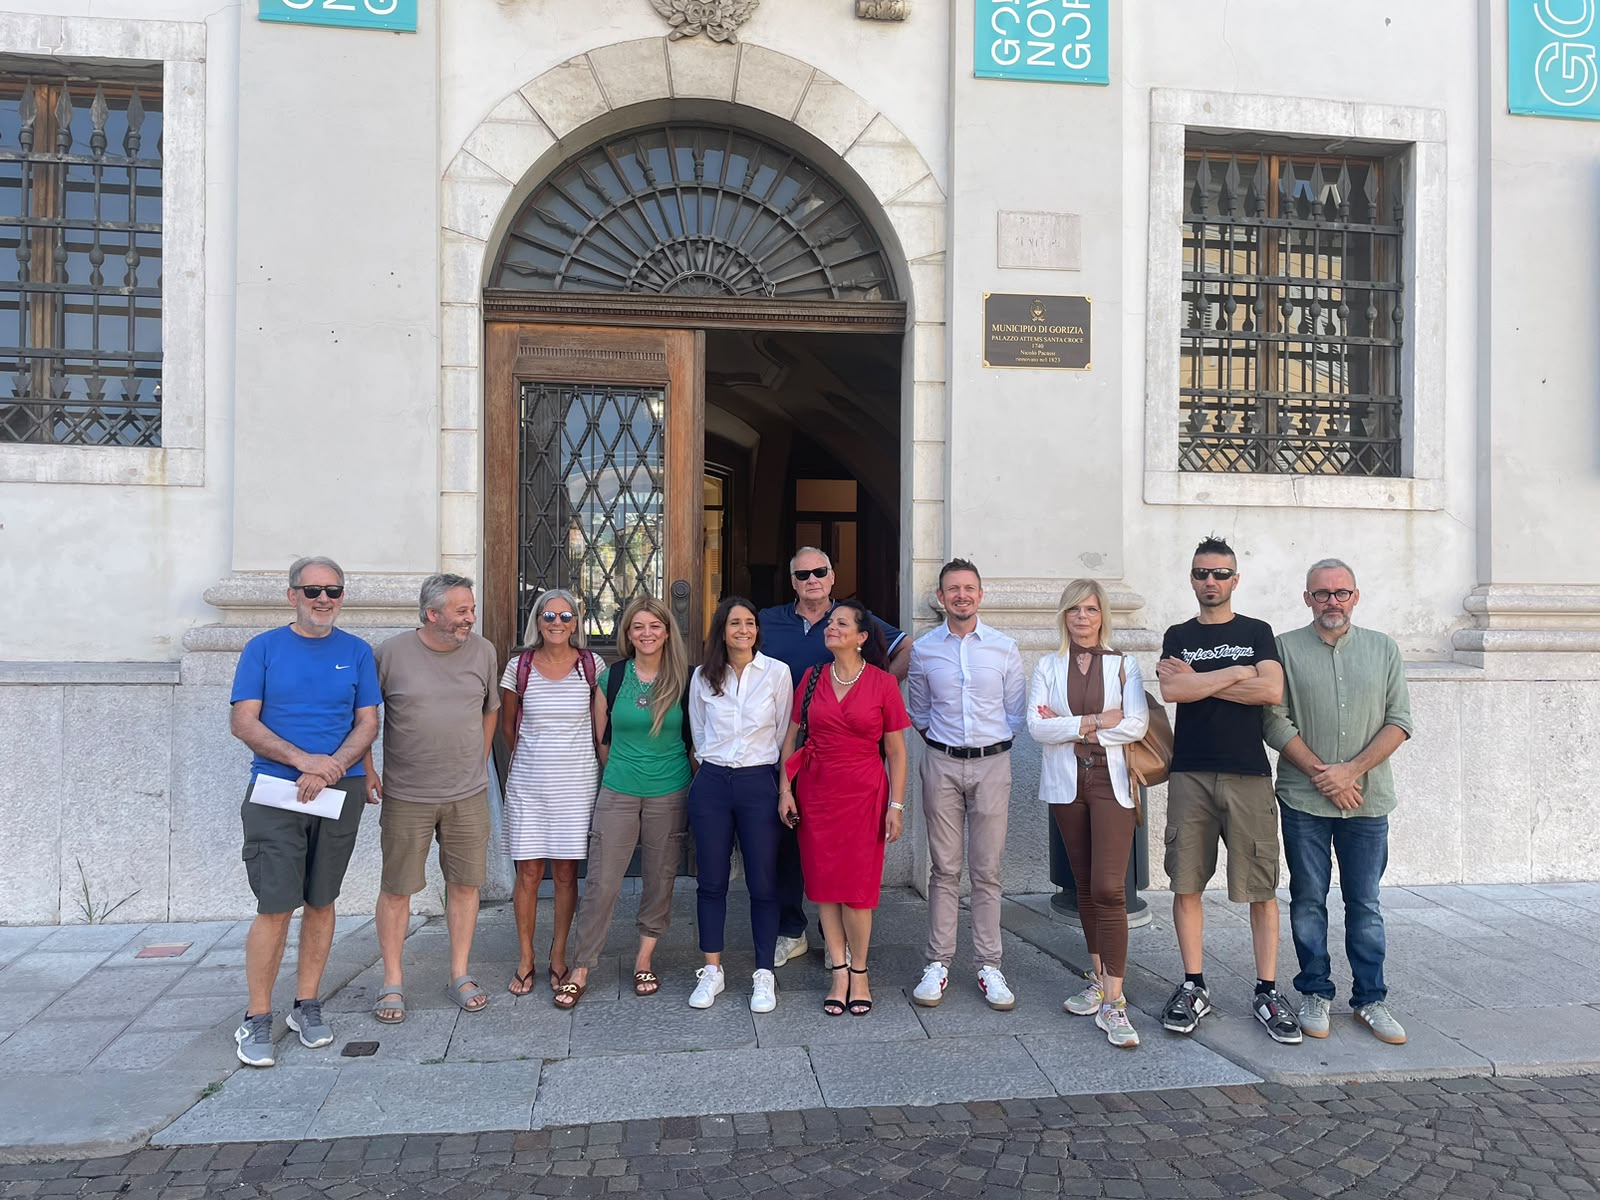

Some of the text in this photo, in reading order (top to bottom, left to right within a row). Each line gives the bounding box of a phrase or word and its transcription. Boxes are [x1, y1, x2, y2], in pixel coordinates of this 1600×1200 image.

[990, 0, 1020, 66] GO
[991, 324, 1084, 335] MUNICIPIO DI GORIZIA
[1194, 647, 1215, 661] Lee
[1213, 643, 1255, 661] Designs
